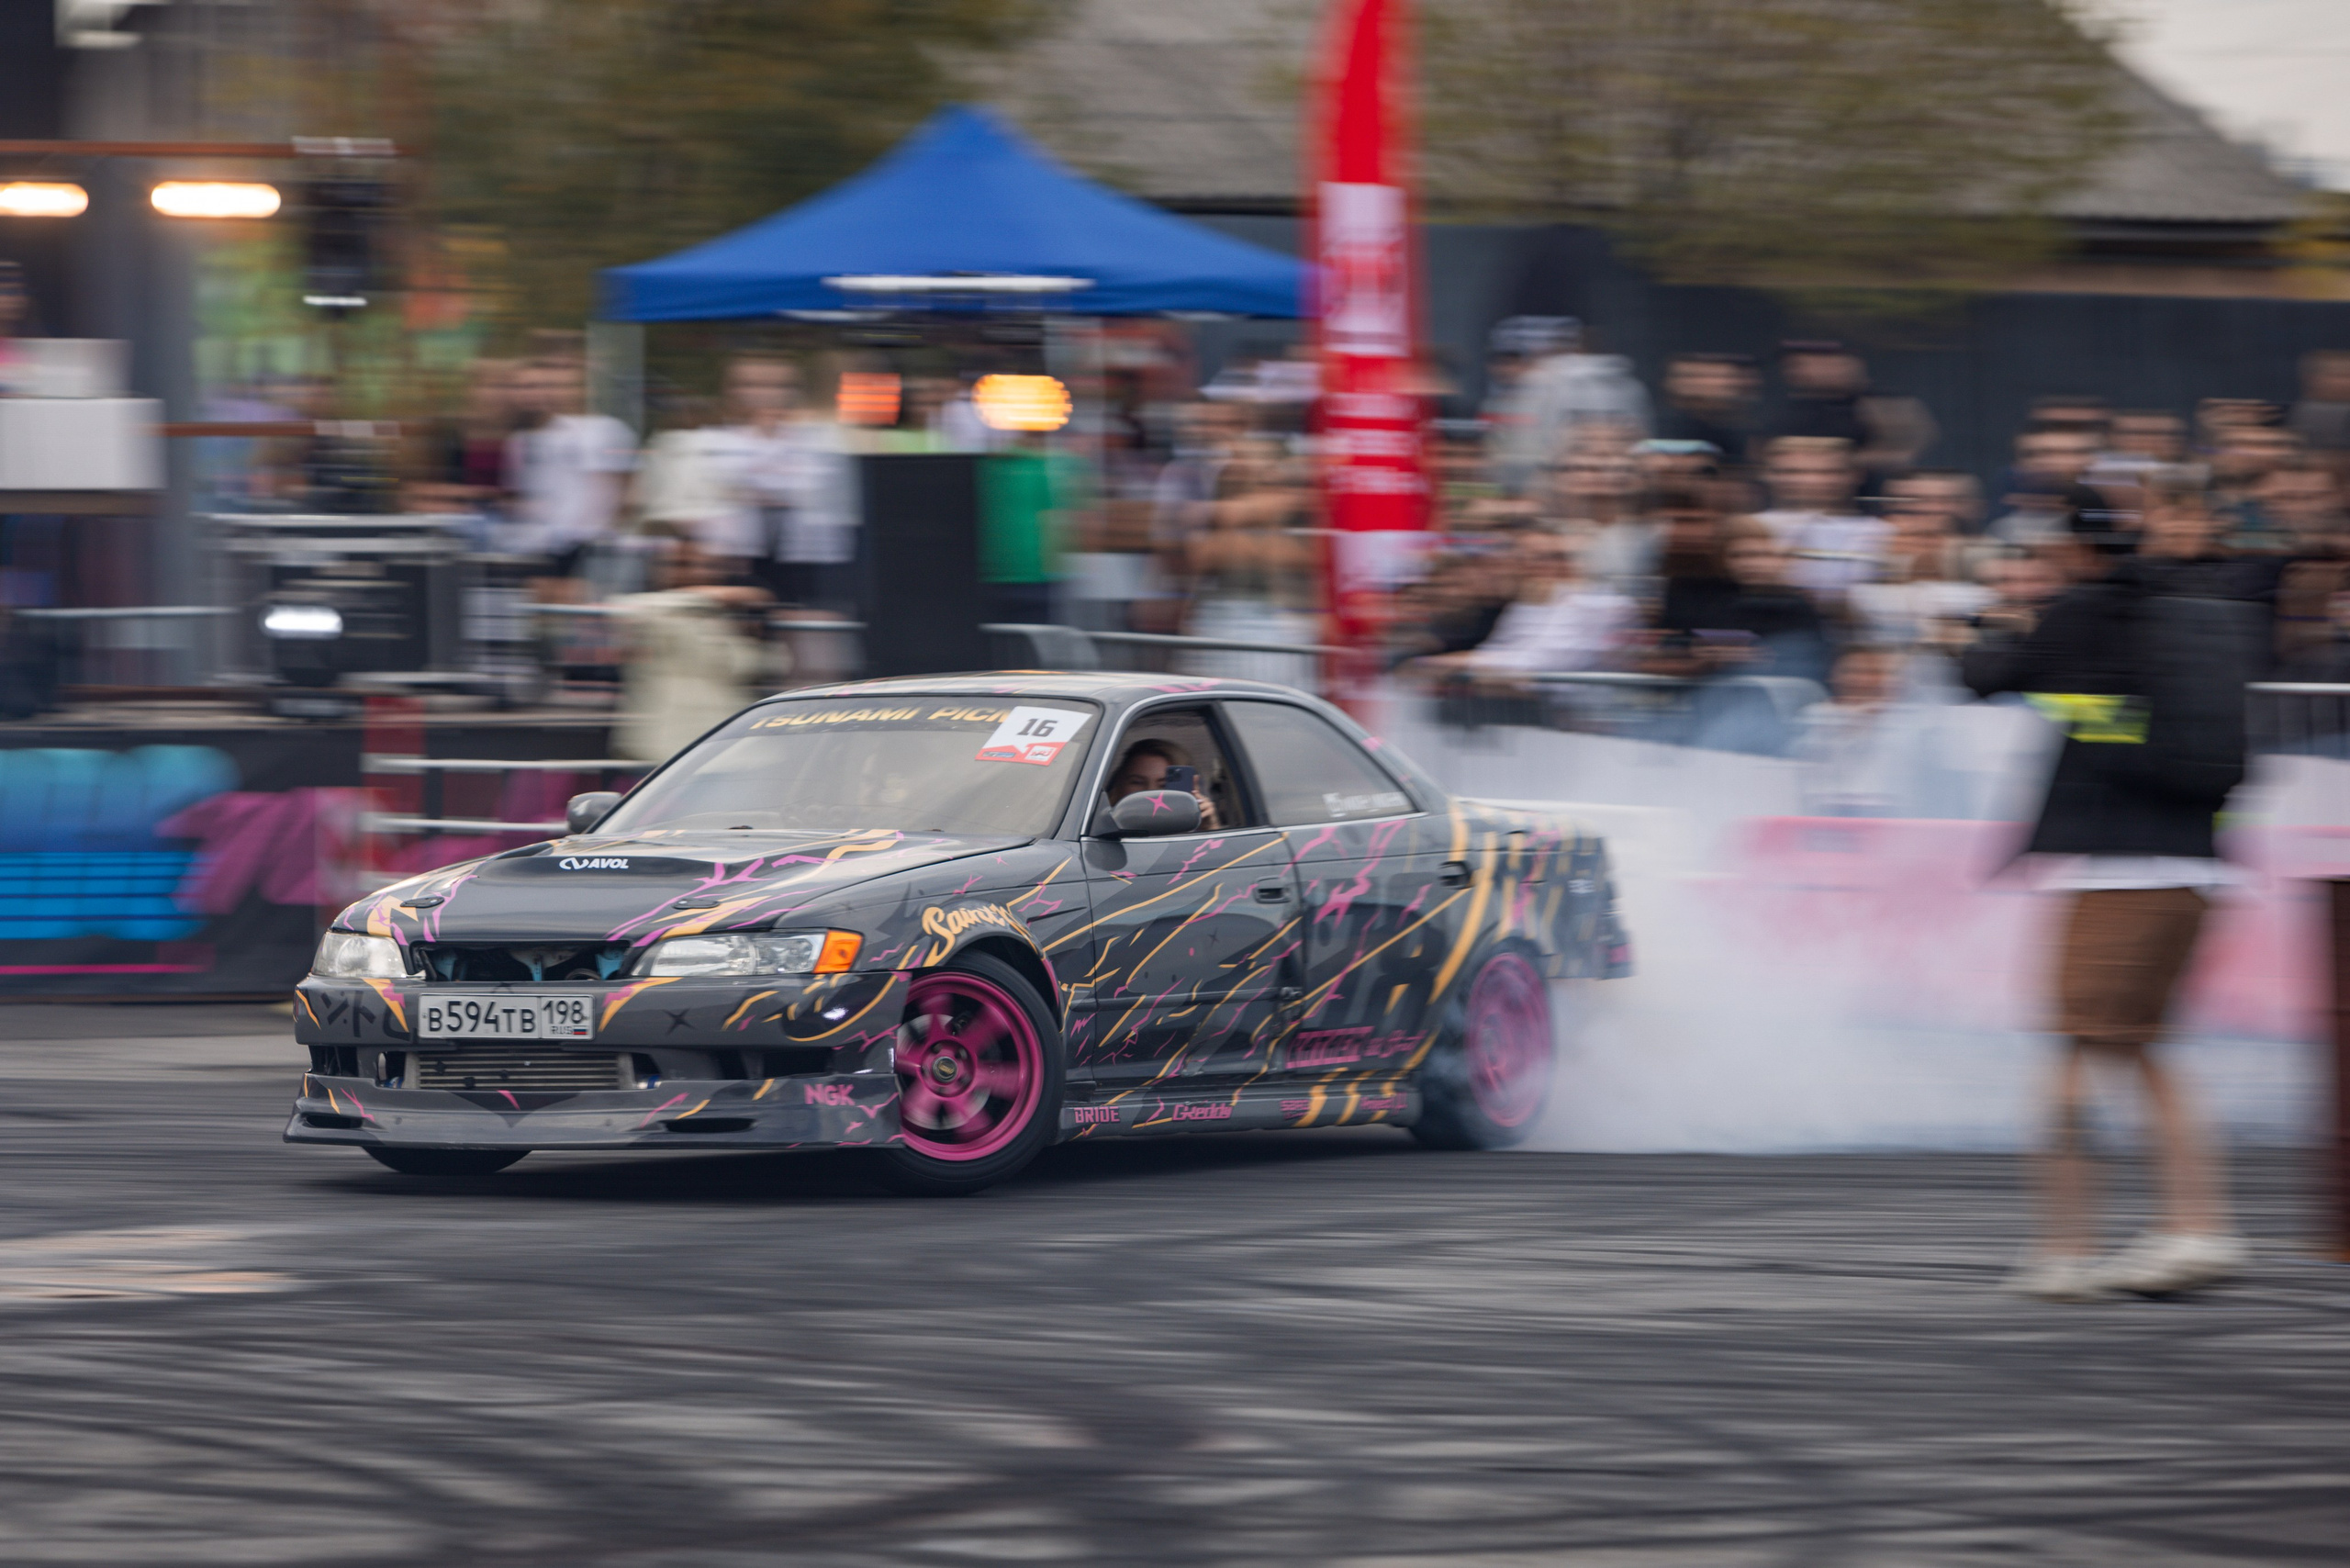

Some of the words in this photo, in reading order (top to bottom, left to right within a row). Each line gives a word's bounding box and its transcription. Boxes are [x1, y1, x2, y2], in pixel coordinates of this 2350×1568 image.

[749, 706, 923, 730] TSUNAMI
[1016, 718, 1058, 737] 16
[428, 1001, 536, 1033] В594ТВ
[543, 1000, 585, 1025] 198
[551, 1026, 573, 1035] RUS
[804, 1083, 856, 1105] NGK
[1074, 1106, 1120, 1124] BRIDE
